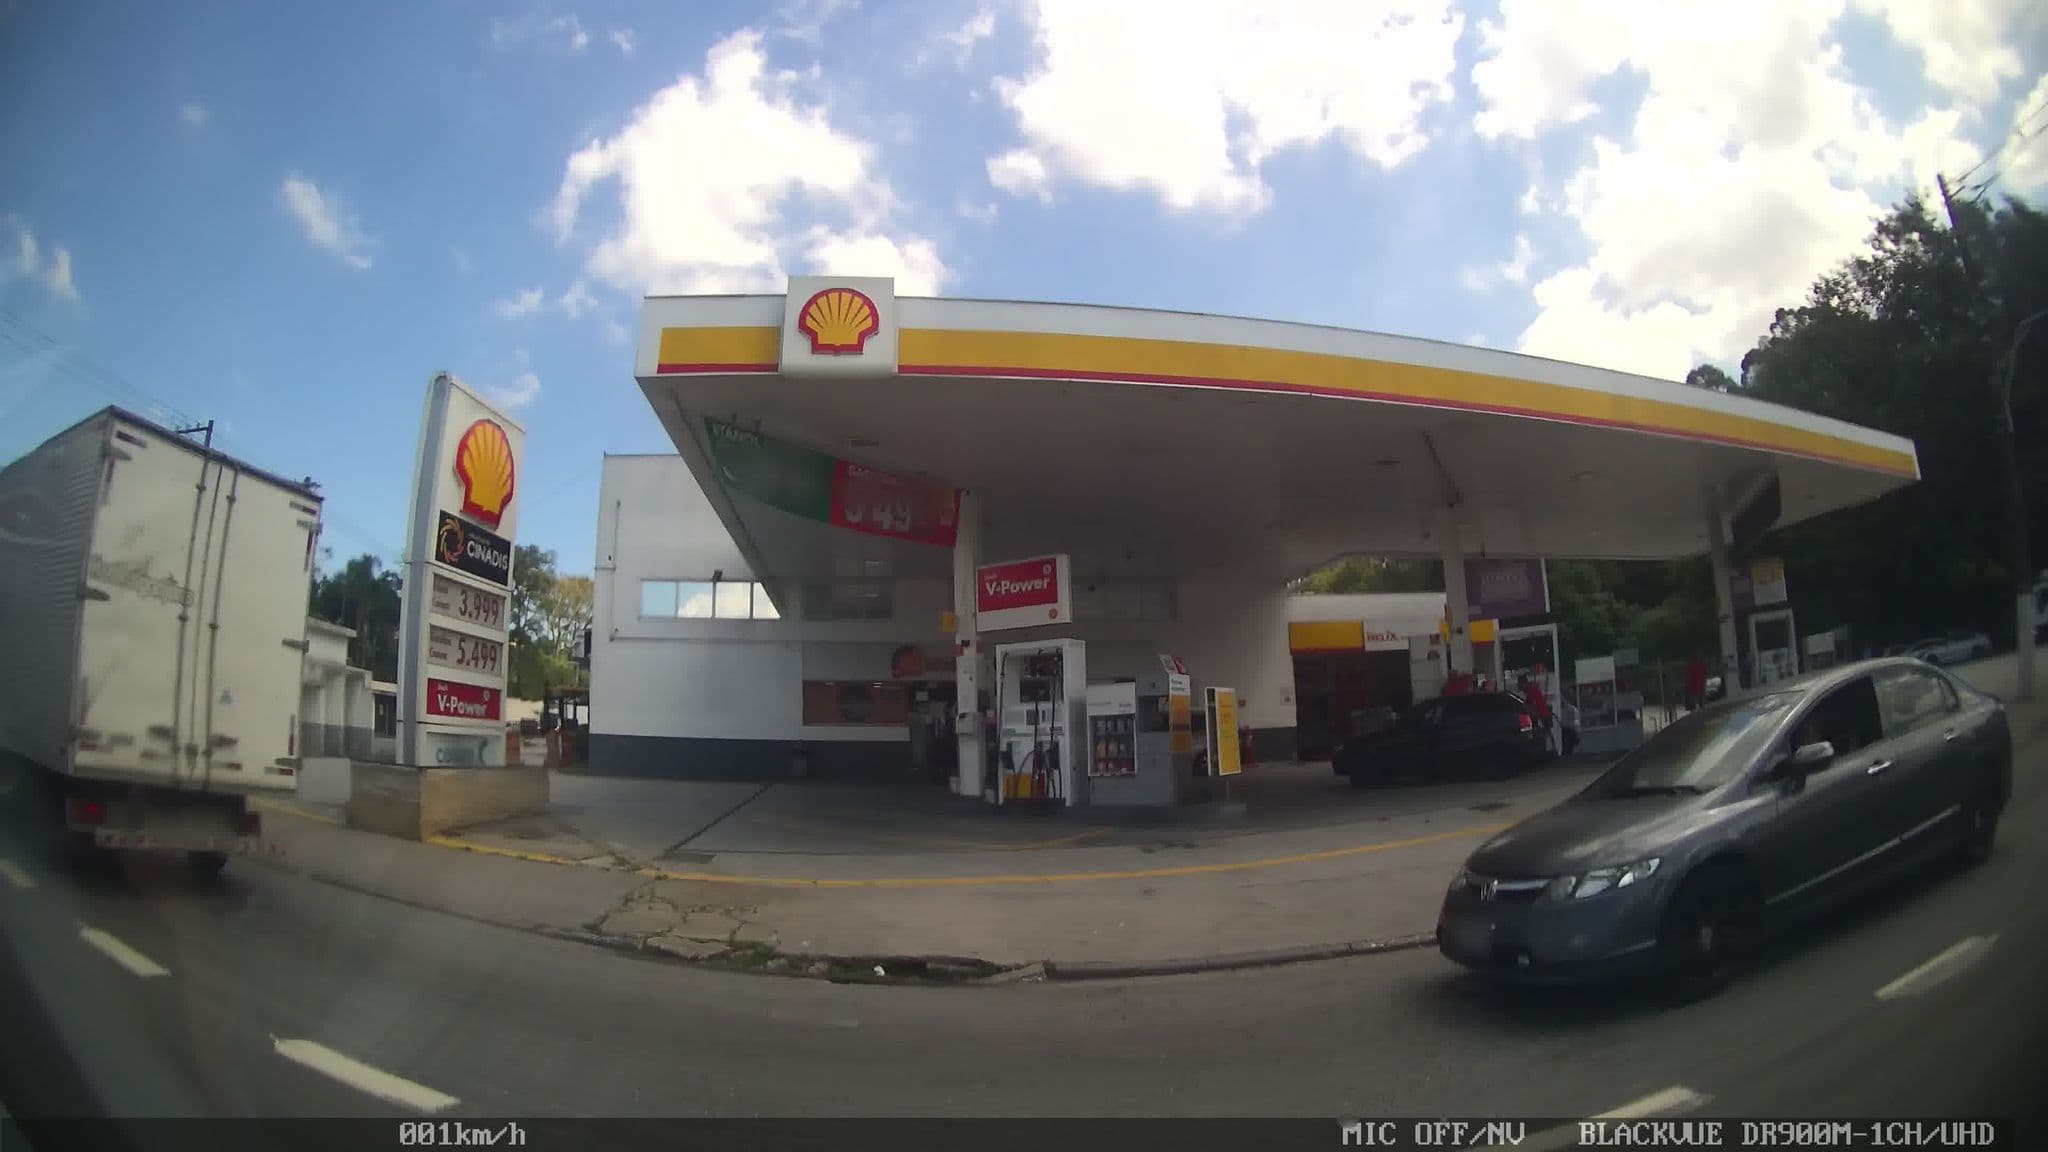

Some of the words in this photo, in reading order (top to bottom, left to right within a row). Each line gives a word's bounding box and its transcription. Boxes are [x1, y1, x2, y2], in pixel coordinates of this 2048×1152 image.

[466, 540, 509, 570] CINADIS
[985, 577, 1051, 597] V-Power
[455, 636, 497, 671] 5.499
[437, 693, 487, 716] V-Power
